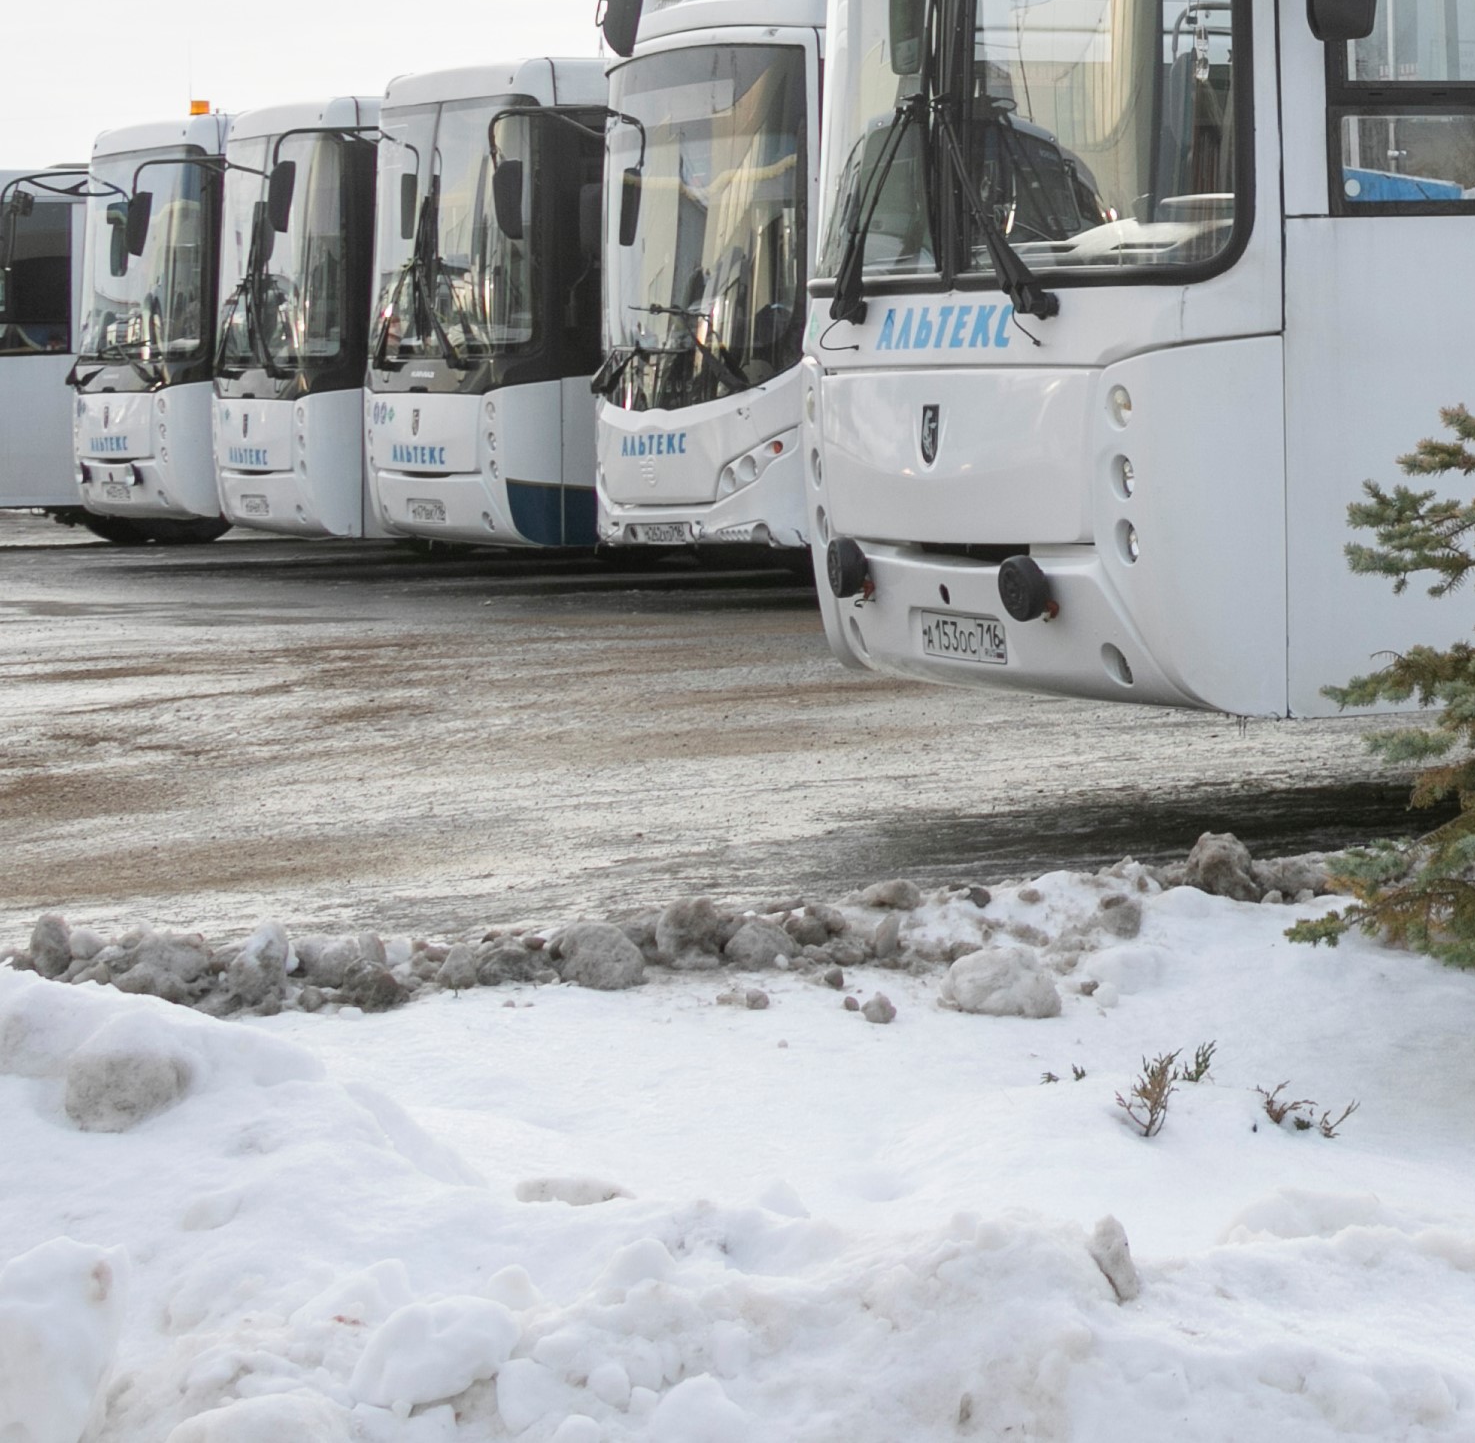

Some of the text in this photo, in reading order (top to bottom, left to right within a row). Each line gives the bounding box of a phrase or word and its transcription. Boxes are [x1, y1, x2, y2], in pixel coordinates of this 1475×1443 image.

[875, 305, 1014, 350] АЛЬТЕКС
[392, 444, 445, 464] АЛЬТЕКС
[622, 432, 686, 456] АЛЬТЕКС
[977, 622, 1000, 649] 716
